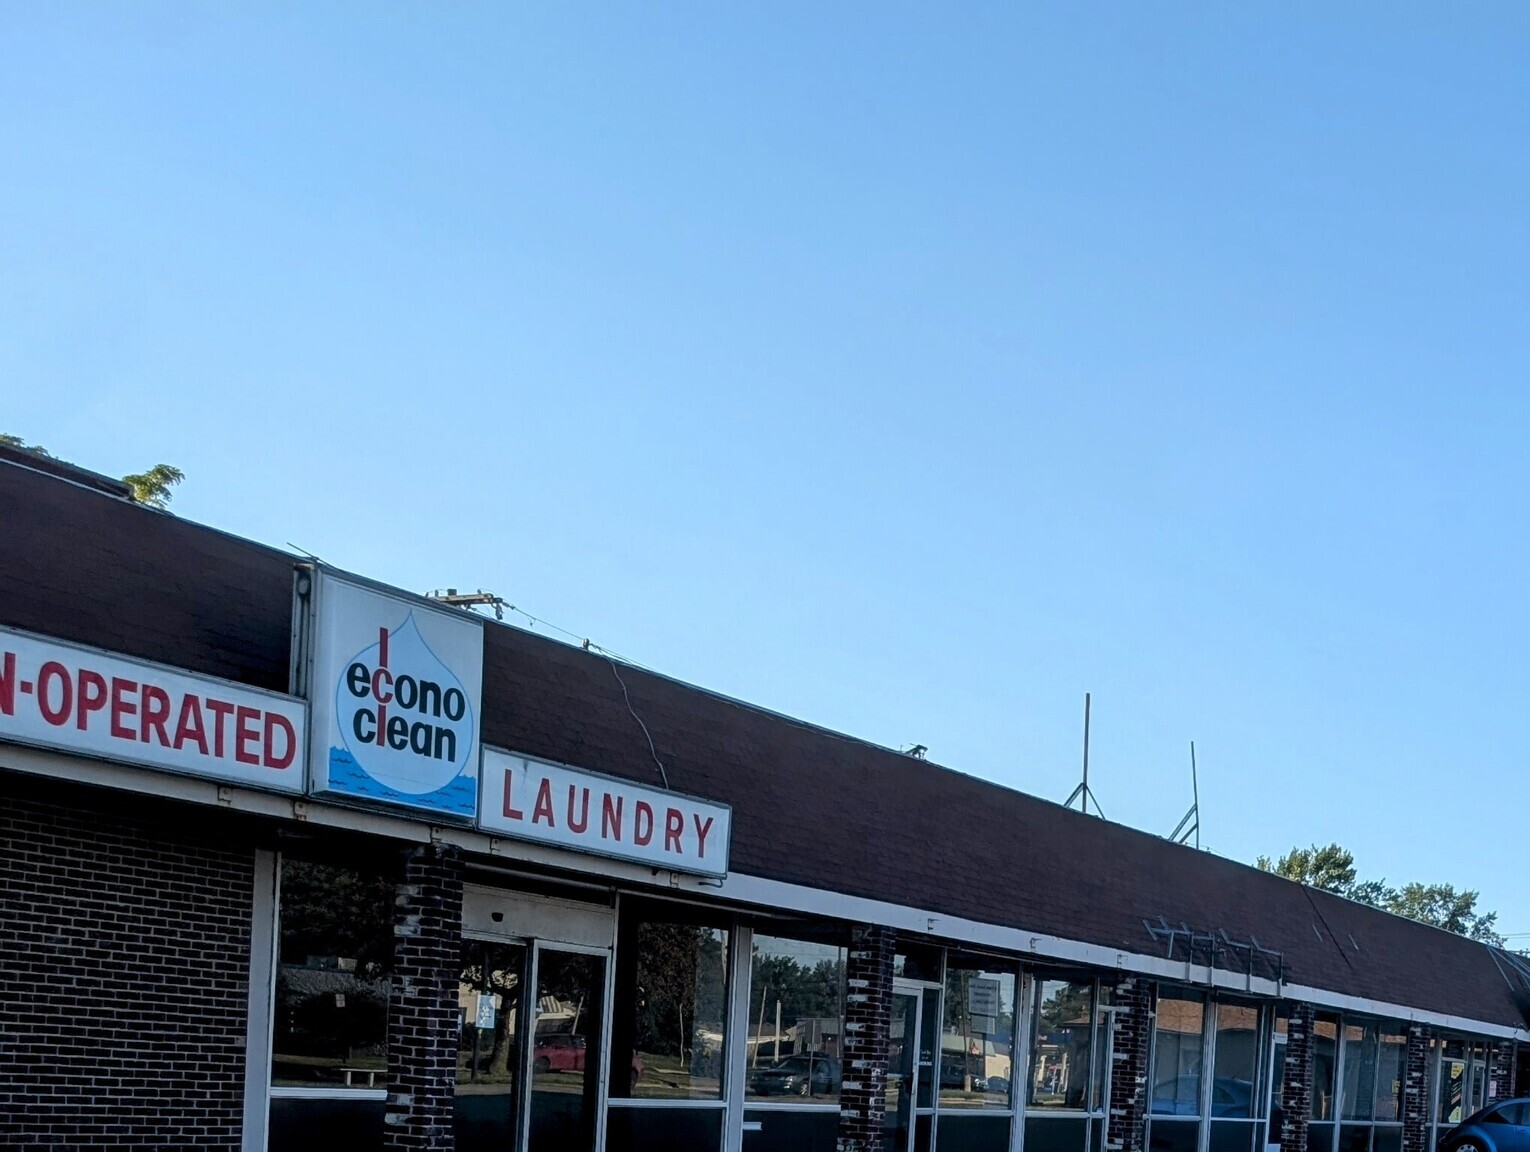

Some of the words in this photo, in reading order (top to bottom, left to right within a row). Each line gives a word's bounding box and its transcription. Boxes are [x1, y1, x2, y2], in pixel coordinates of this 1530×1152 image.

[346, 661, 466, 722] econo
[353, 703, 457, 763] clean
[503, 769, 716, 859] LAUNDRY
